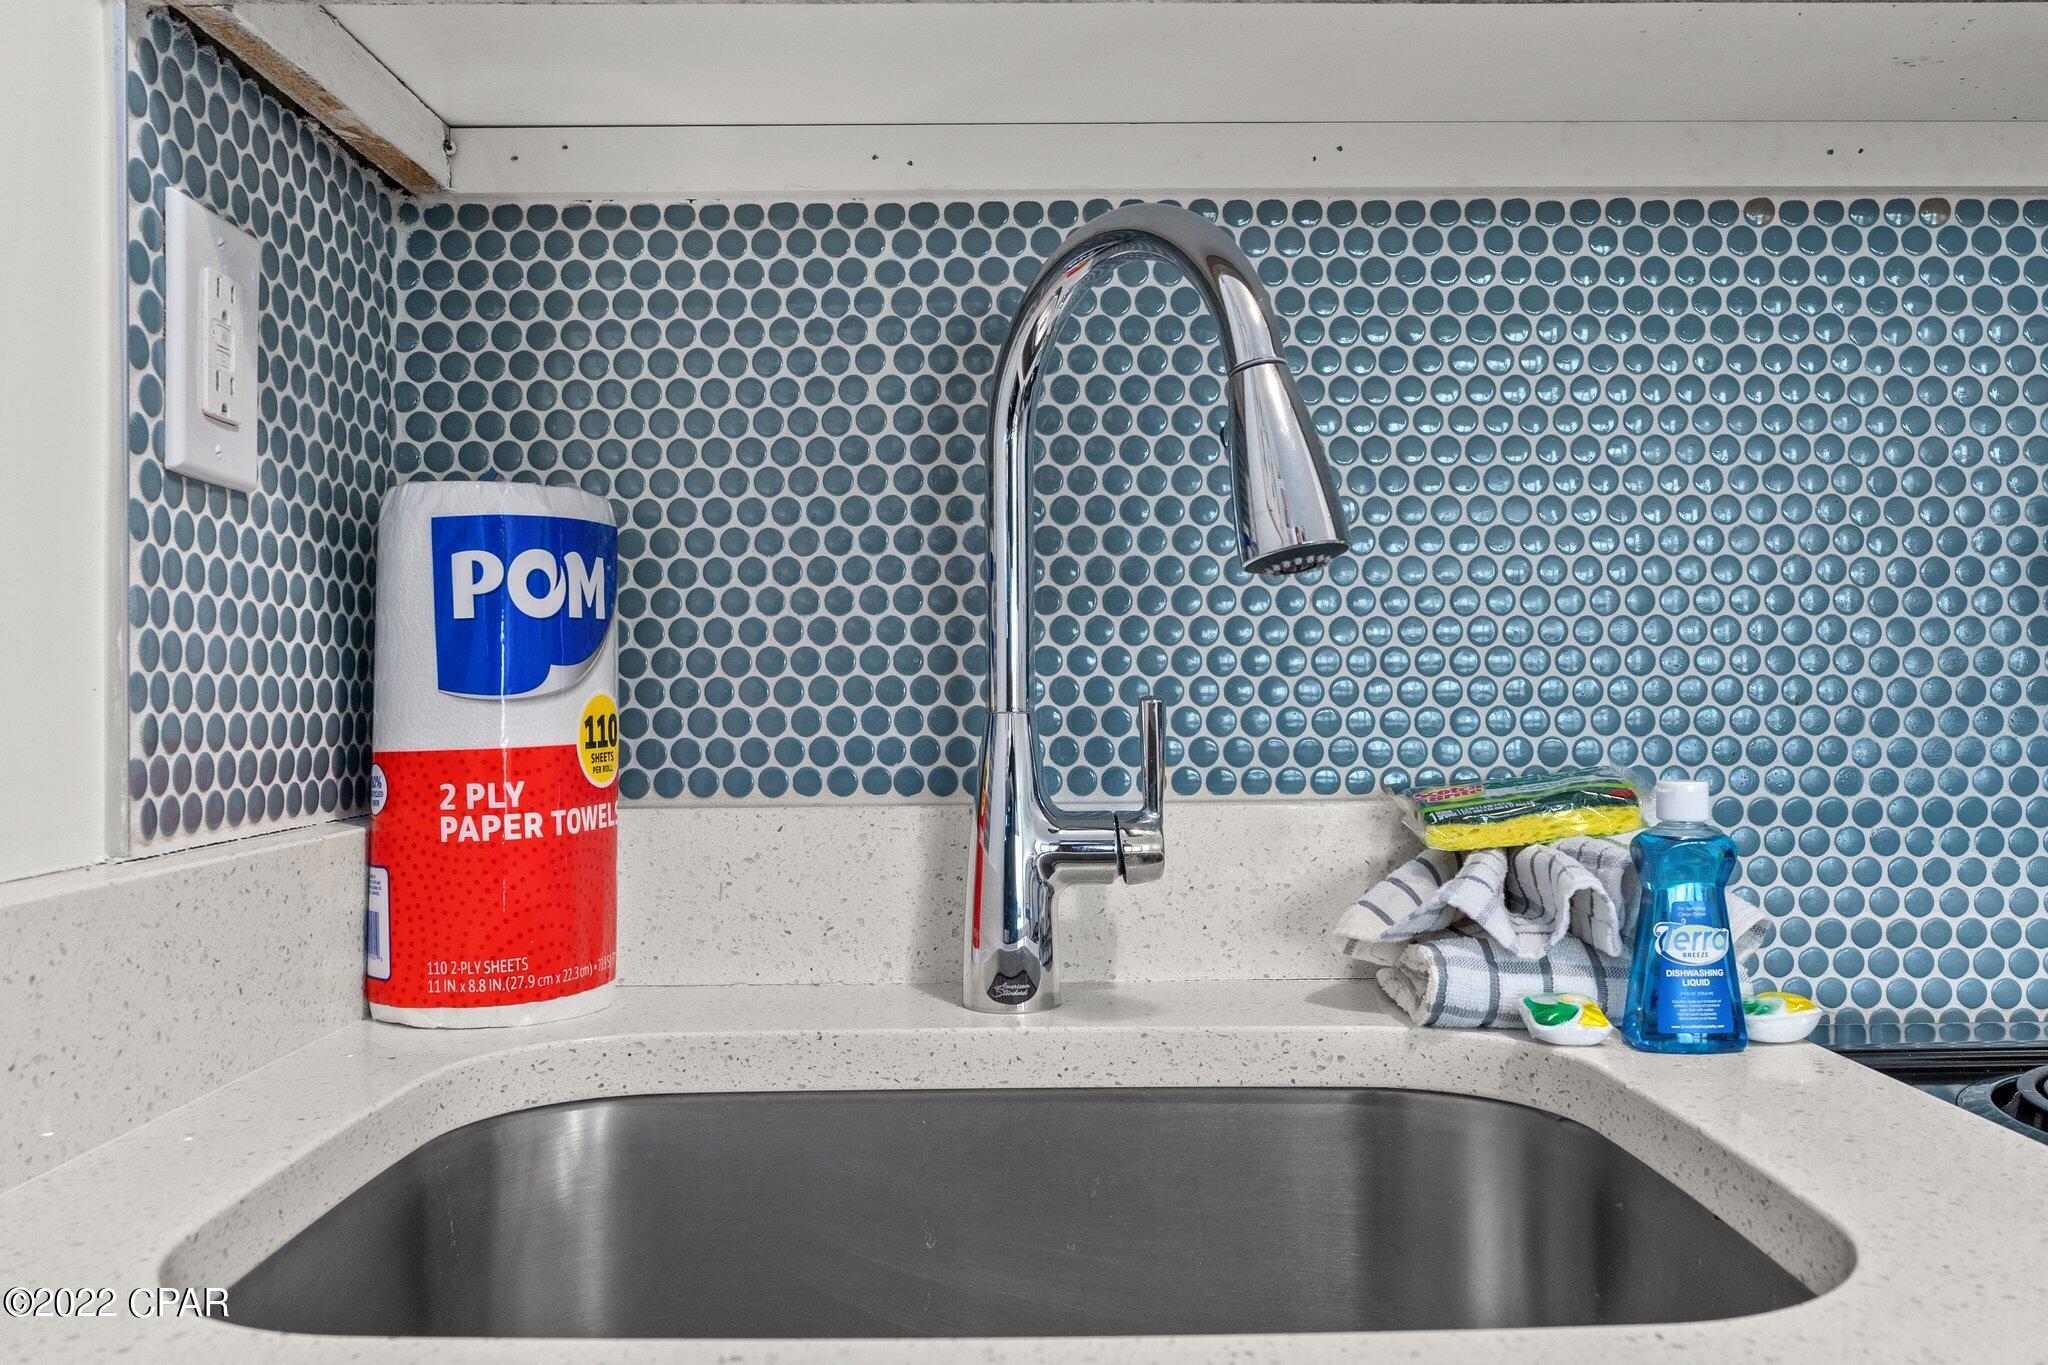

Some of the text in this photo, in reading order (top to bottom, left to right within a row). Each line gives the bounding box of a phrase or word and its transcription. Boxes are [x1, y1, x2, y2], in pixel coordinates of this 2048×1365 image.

[451, 549, 605, 620] POM
[584, 713, 618, 750] 110
[591, 751, 614, 764] SHEETS
[593, 764, 614, 774] PER ROLL
[440, 781, 525, 810] 2 PLY
[440, 812, 543, 842] PAPER
[1653, 918, 1729, 952] Terra
[427, 957, 529, 975] 110 2-PLY SHEETS
[428, 980, 441, 993] 11
[460, 982, 466, 993] x
[468, 979, 486, 992] 8.8
[537, 974, 553, 987] cm
[562, 966, 579, 982] 22.3
[1665, 969, 1724, 977] DISHWASHING
[1682, 979, 1711, 987] LIQUID
